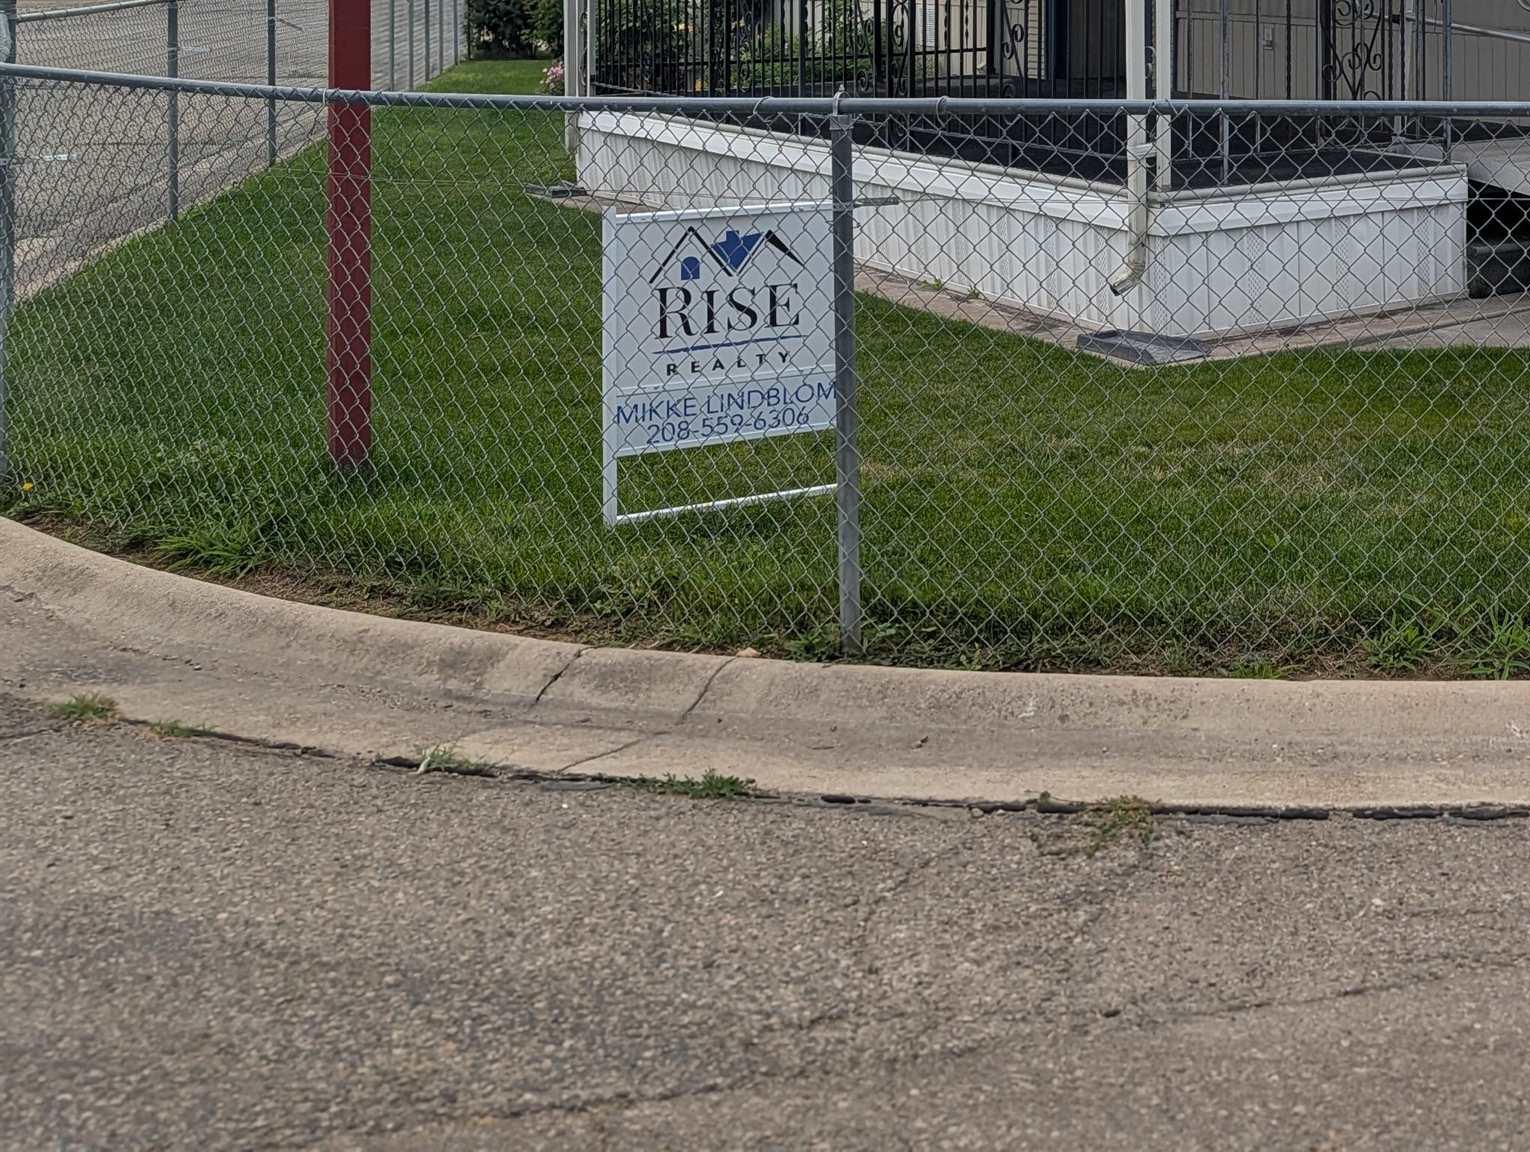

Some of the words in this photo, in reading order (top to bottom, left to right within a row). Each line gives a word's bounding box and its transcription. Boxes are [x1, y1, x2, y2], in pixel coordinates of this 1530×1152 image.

[655, 283, 800, 339] RISE
[666, 352, 789, 376] REALTY
[617, 398, 698, 425] MIKKE
[707, 382, 837, 414] LINDBLOM
[647, 407, 810, 445] 208-559-6306
